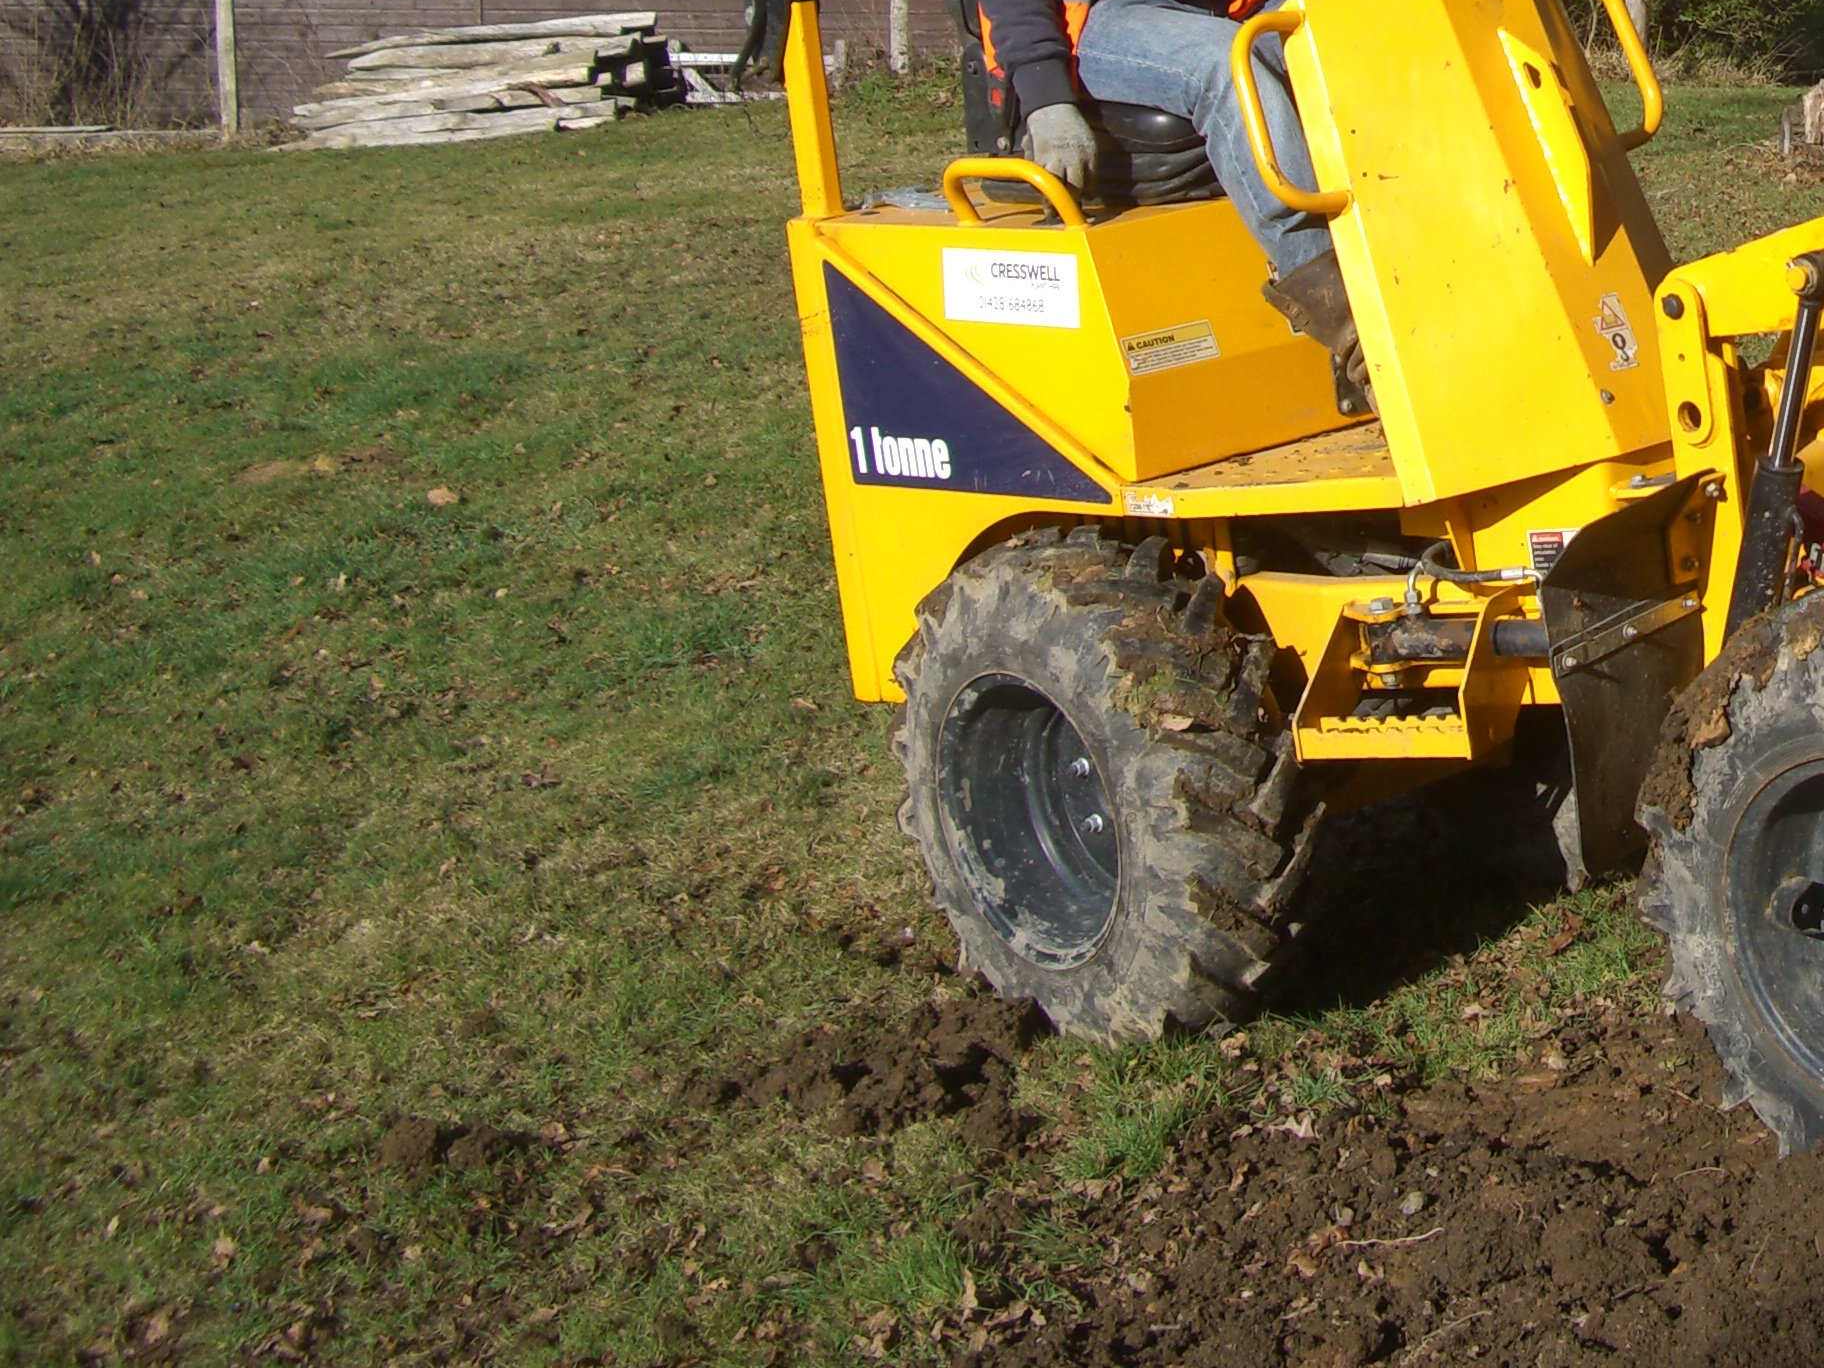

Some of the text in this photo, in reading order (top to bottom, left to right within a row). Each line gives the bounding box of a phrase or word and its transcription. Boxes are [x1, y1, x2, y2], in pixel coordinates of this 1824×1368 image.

[991, 263, 1060, 281] CRESSWELL
[1008, 297, 1045, 313] 684868
[1136, 335, 1175, 349] CAUTION
[850, 426, 952, 480] 1 tonne
